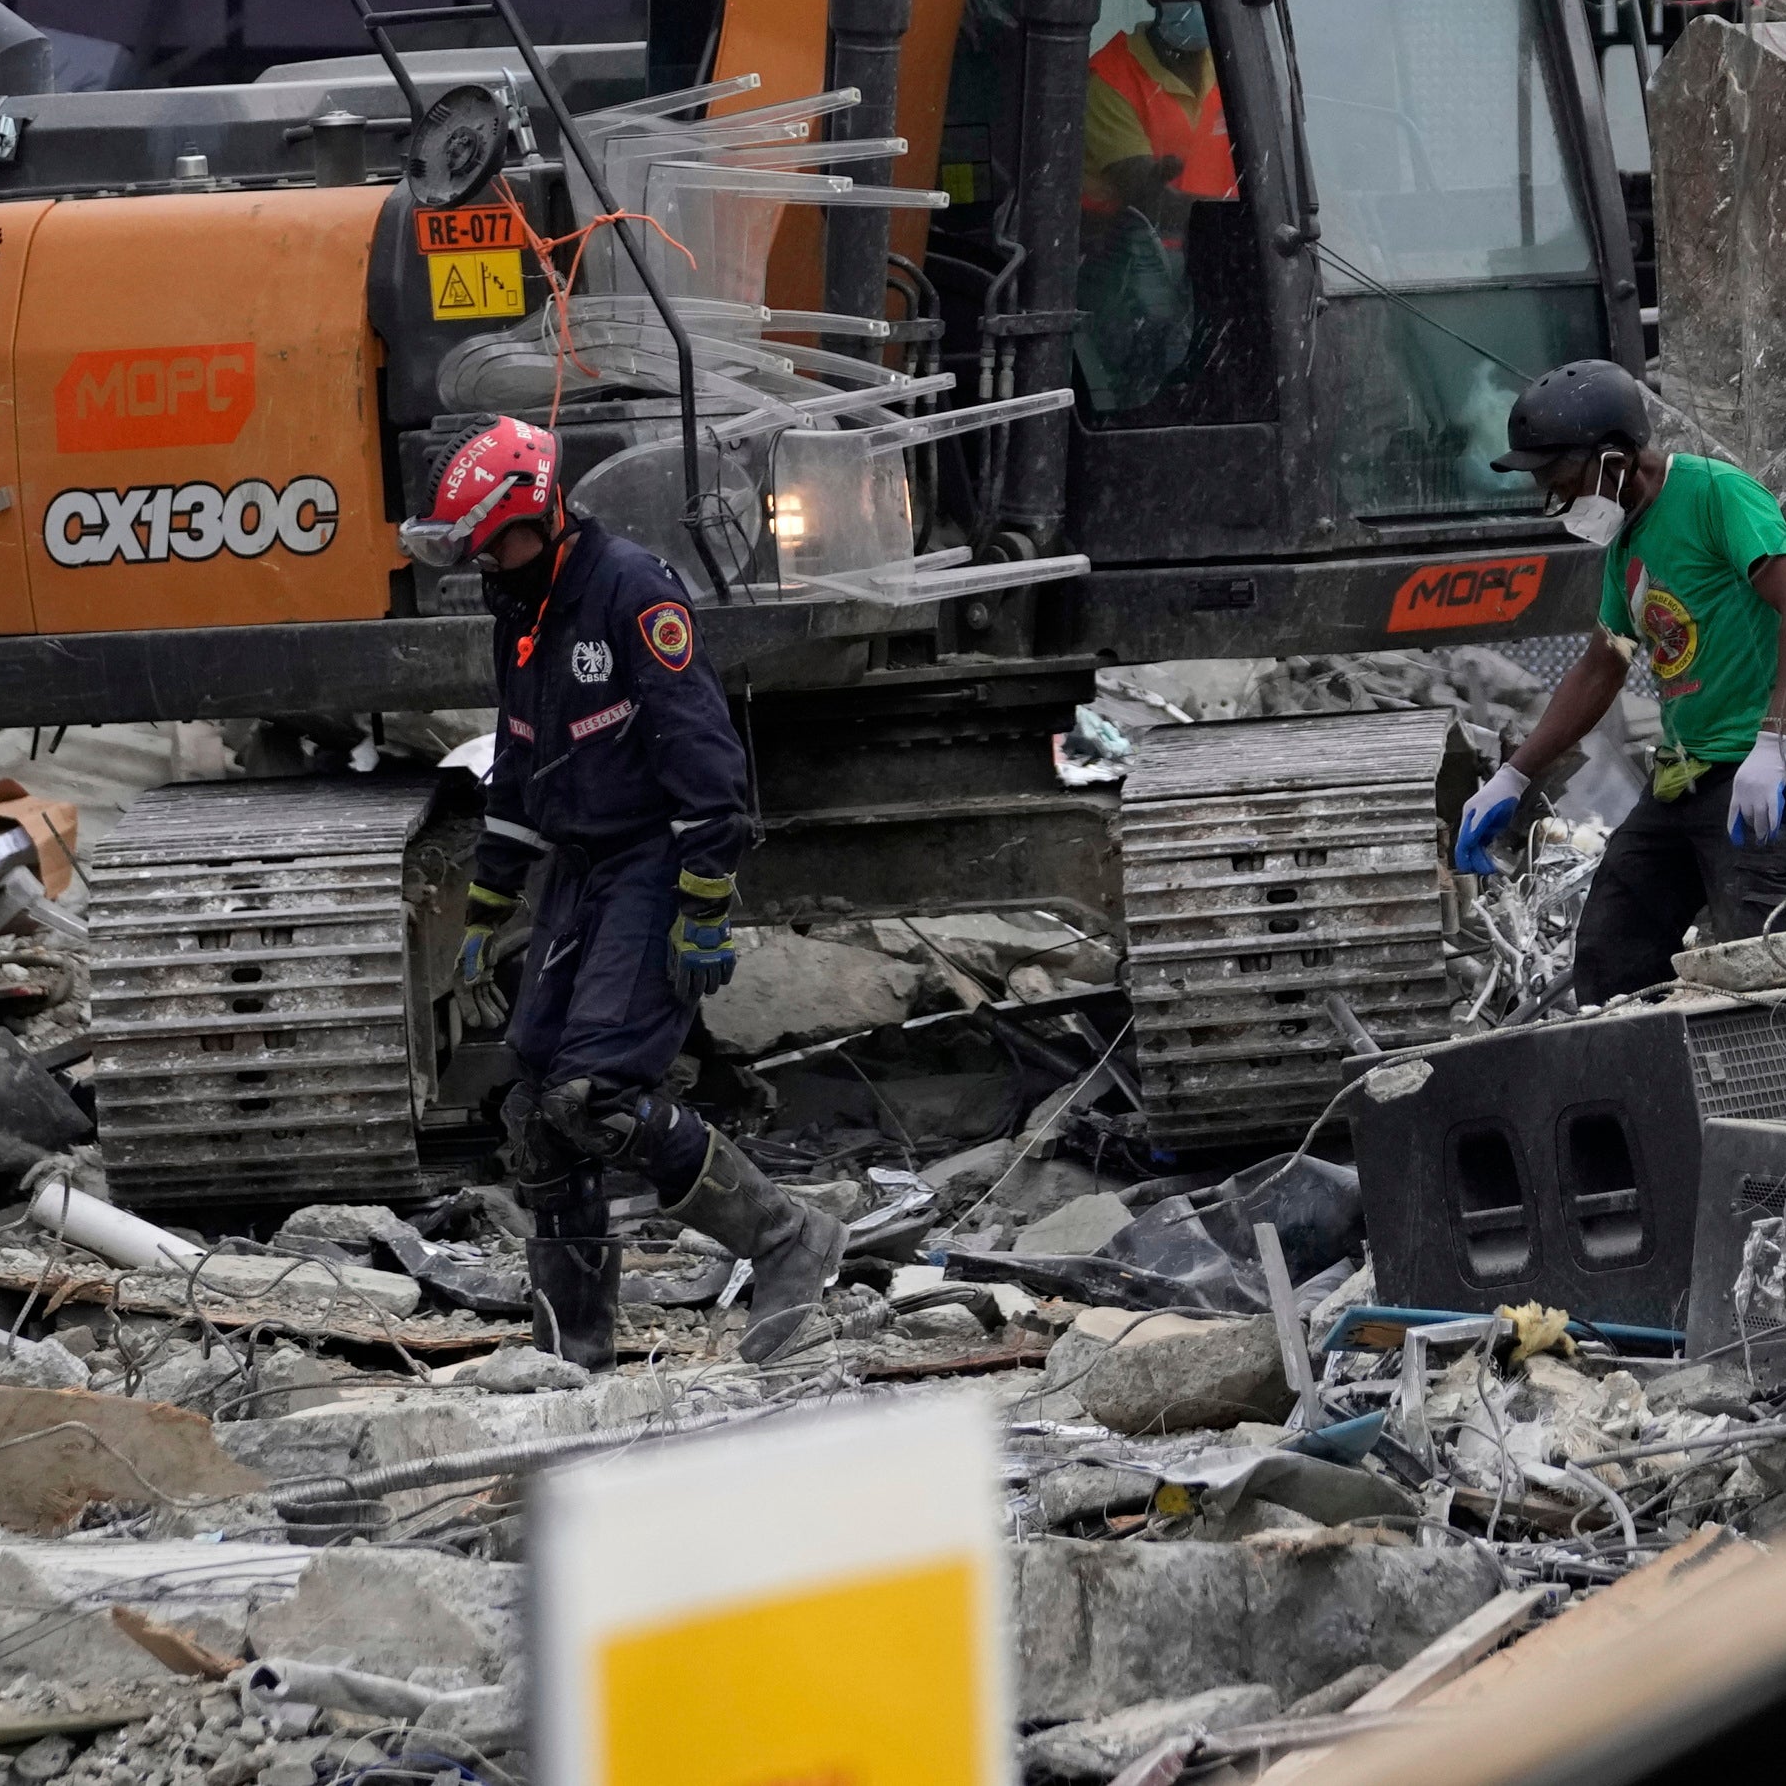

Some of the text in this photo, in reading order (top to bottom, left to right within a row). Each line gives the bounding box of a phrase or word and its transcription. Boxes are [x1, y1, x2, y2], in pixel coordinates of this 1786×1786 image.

[427, 213, 512, 245] RE-077
[75, 354, 244, 419] MOPC
[474, 466, 496, 483] 1
[532, 459, 551, 503] SDE
[43, 474, 339, 569] CX130C
[1408, 565, 1537, 610] MOPC
[580, 673, 609, 683] CBSIE
[576, 702, 632, 734] RESCATE
